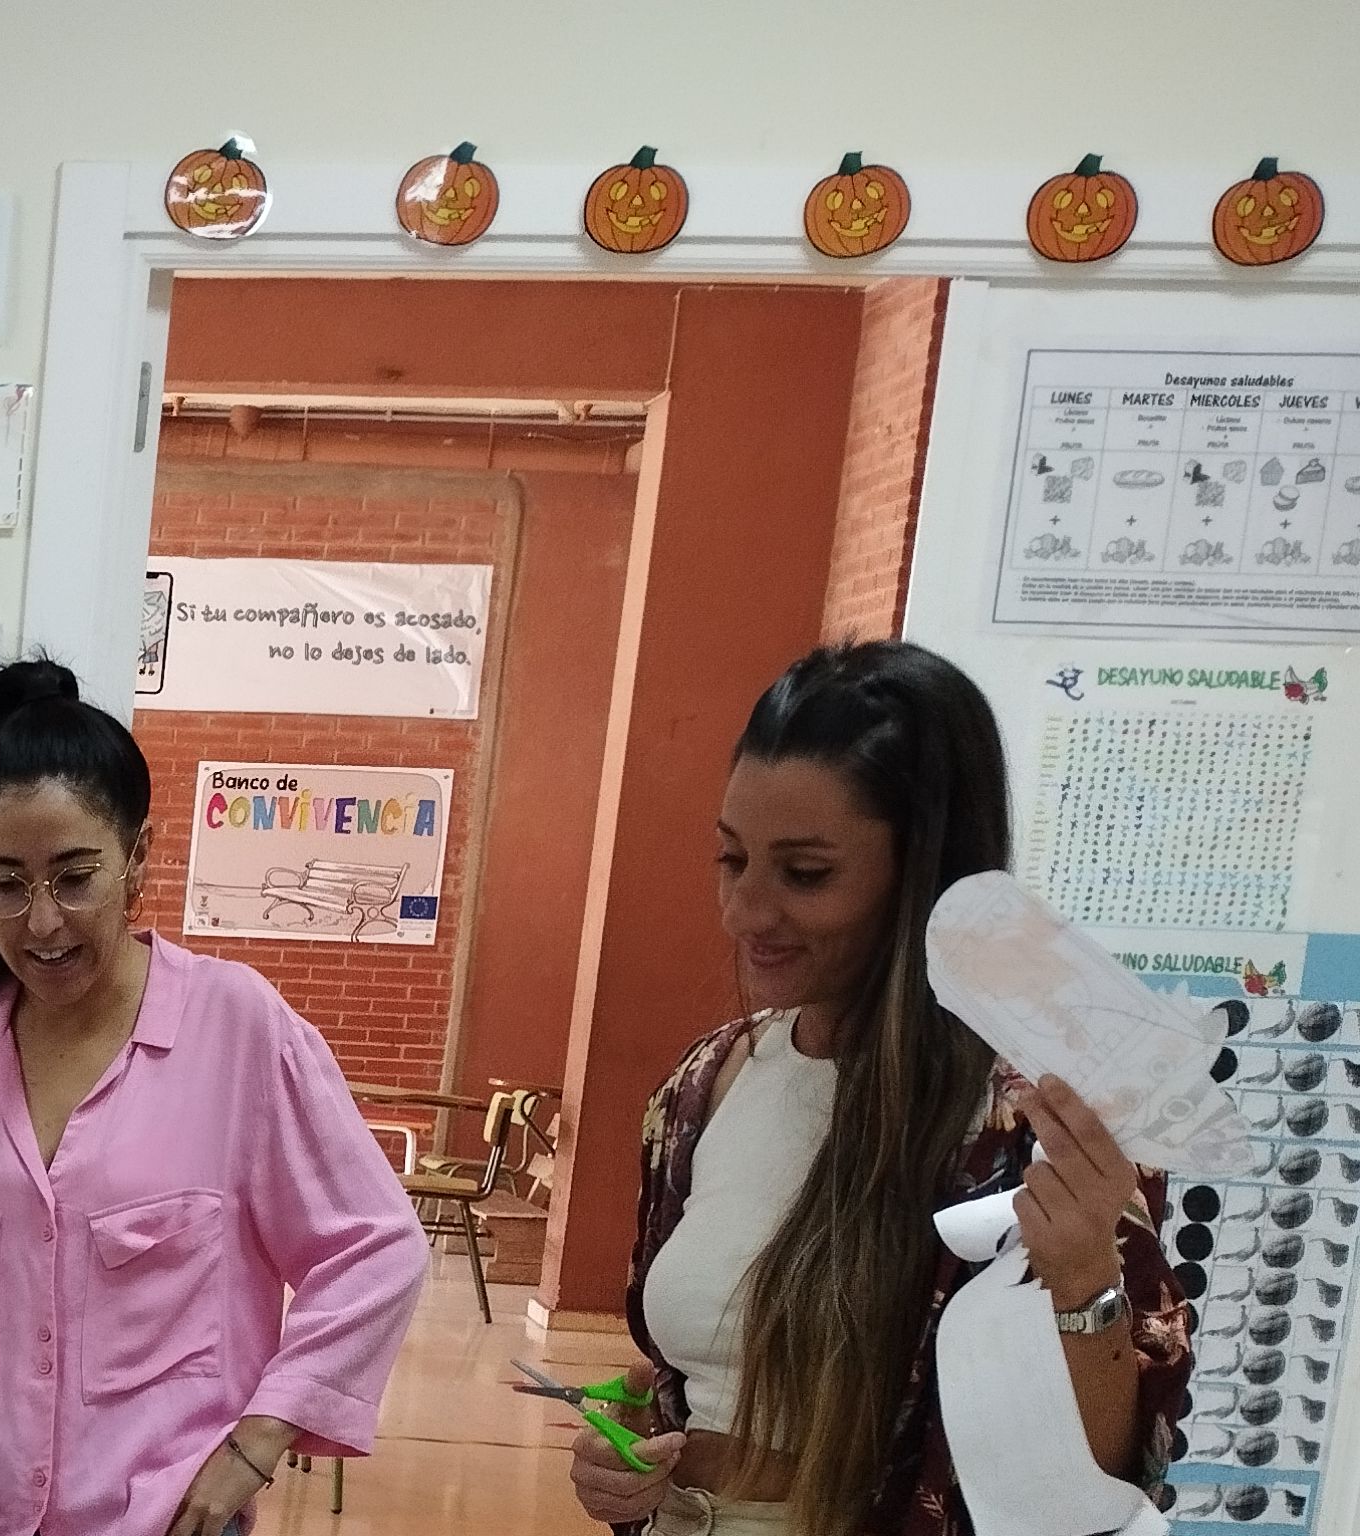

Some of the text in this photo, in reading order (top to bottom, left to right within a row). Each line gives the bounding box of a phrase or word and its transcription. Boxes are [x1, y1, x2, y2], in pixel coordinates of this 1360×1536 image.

[1165, 372, 1294, 388] Desayunos saludables
[1051, 392, 1092, 404] LUNES
[1122, 393, 1174, 406] MARTES
[1190, 394, 1261, 408] MIERCOLES
[1279, 396, 1329, 408] JUEVES
[176, 602, 482, 635] Si tu compañero es acosado,
[268, 642, 471, 666] no lo dejes de lado.
[1097, 668, 1281, 690] DESAYUNO SALUDABLE
[212, 772, 298, 792] Banco de
[1152, 954, 1244, 974] SALUDABLE
